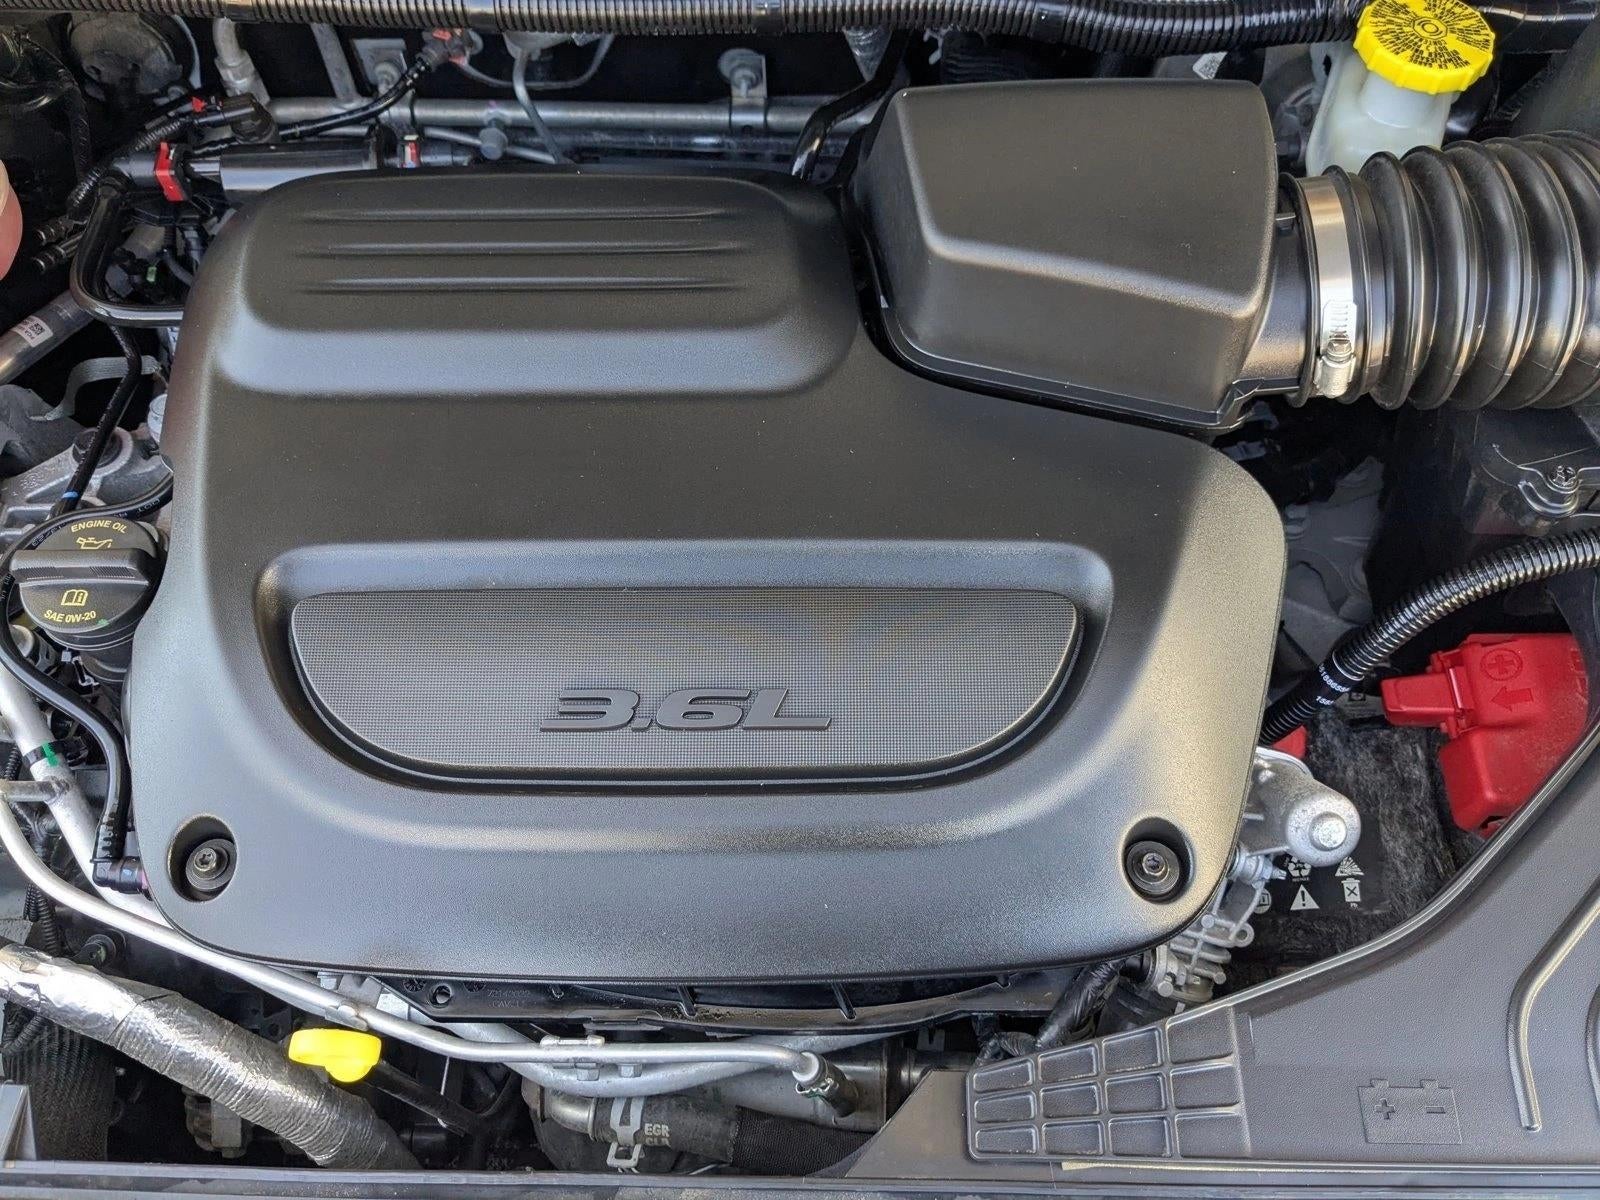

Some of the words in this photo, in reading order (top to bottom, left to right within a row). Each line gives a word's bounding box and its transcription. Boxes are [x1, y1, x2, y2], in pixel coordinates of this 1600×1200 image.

[71, 519, 111, 532] ENGINE
[112, 522, 127, 534] OIL
[44, 609, 65, 623] SAE
[65, 610, 97, 623] 0W-20
[540, 687, 832, 732] 3.6L
[644, 1123, 670, 1137] EGR
